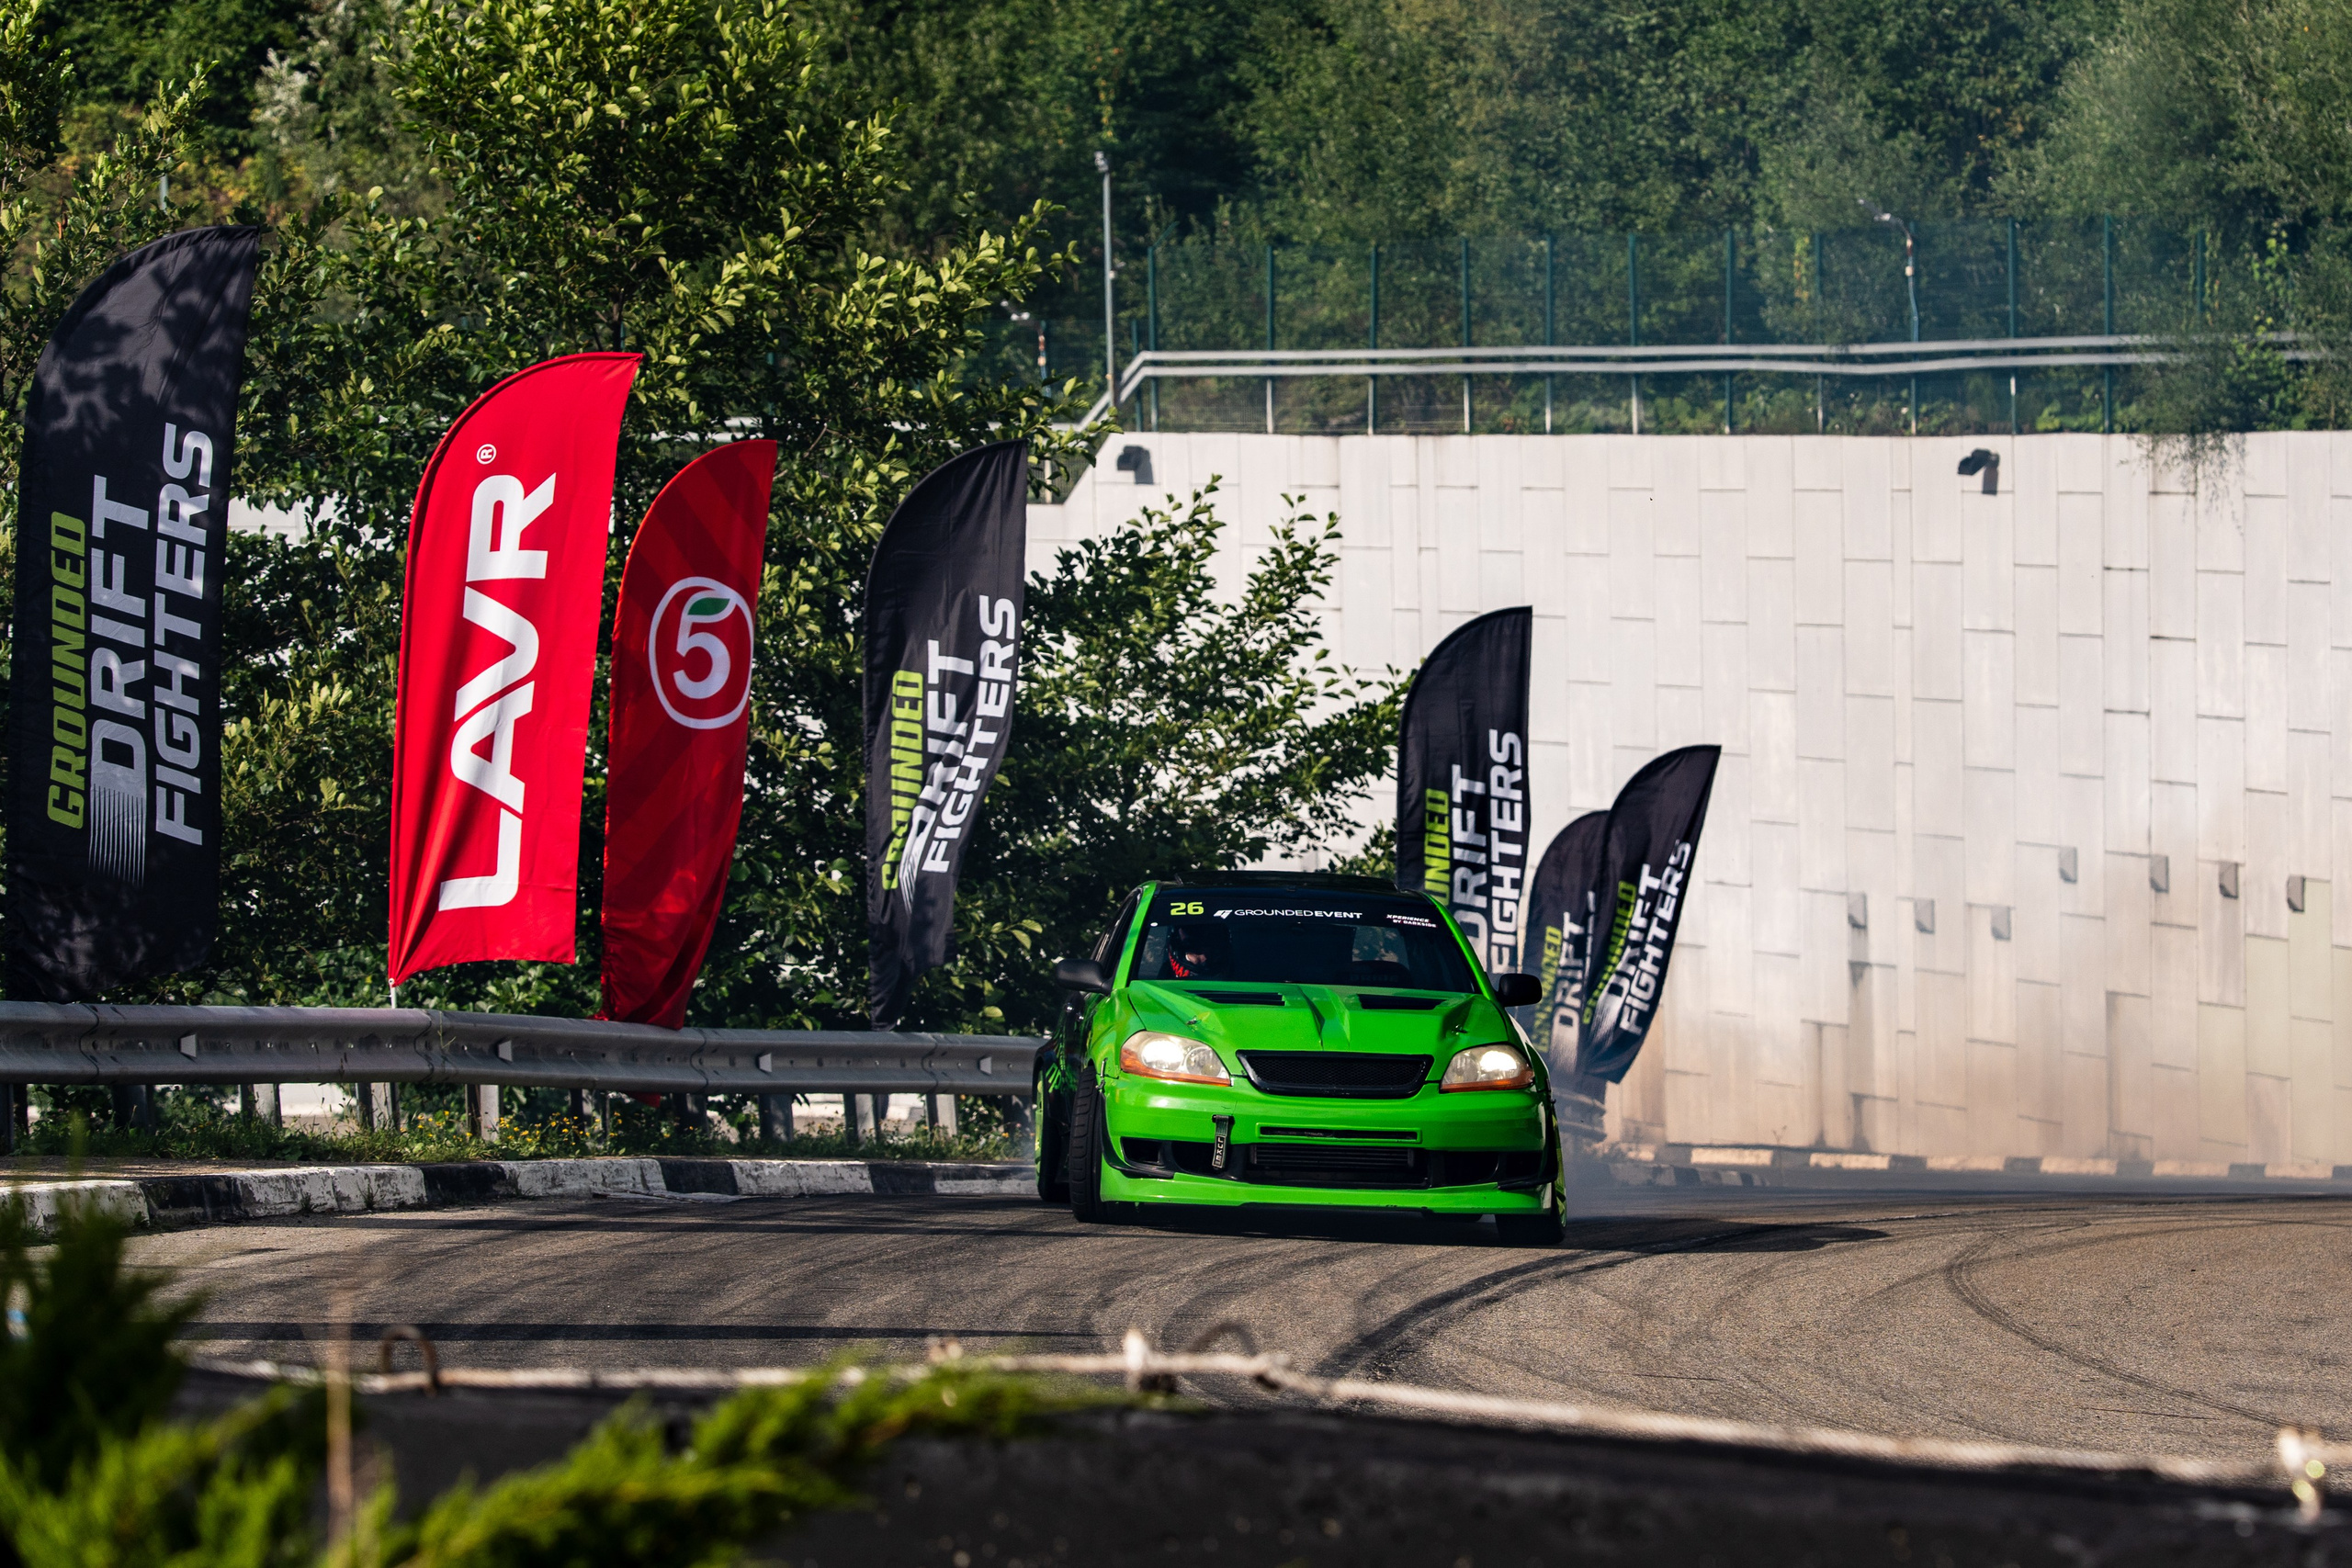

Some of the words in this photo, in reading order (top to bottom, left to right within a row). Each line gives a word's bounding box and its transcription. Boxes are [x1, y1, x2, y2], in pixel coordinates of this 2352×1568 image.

[47, 511, 85, 829] GROUNDED
[89, 475, 149, 886] DRIFT
[154, 422, 213, 845] FIGHTERS
[438, 471, 557, 912] LAVR
[673, 591, 734, 700] 5
[922, 594, 1016, 874] FIGHTERS
[899, 639, 975, 917] DRIFT
[1424, 788, 1451, 907] UNDED
[1488, 728, 1522, 974] FIGHTERS
[1170, 901, 1204, 916] 26
[1533, 925, 1562, 1054] GNDED
[1549, 911, 1585, 1072] DRIFT
[1590, 863, 1661, 1043] DRIFT
[1619, 839, 1691, 1036] FIGHTERS
